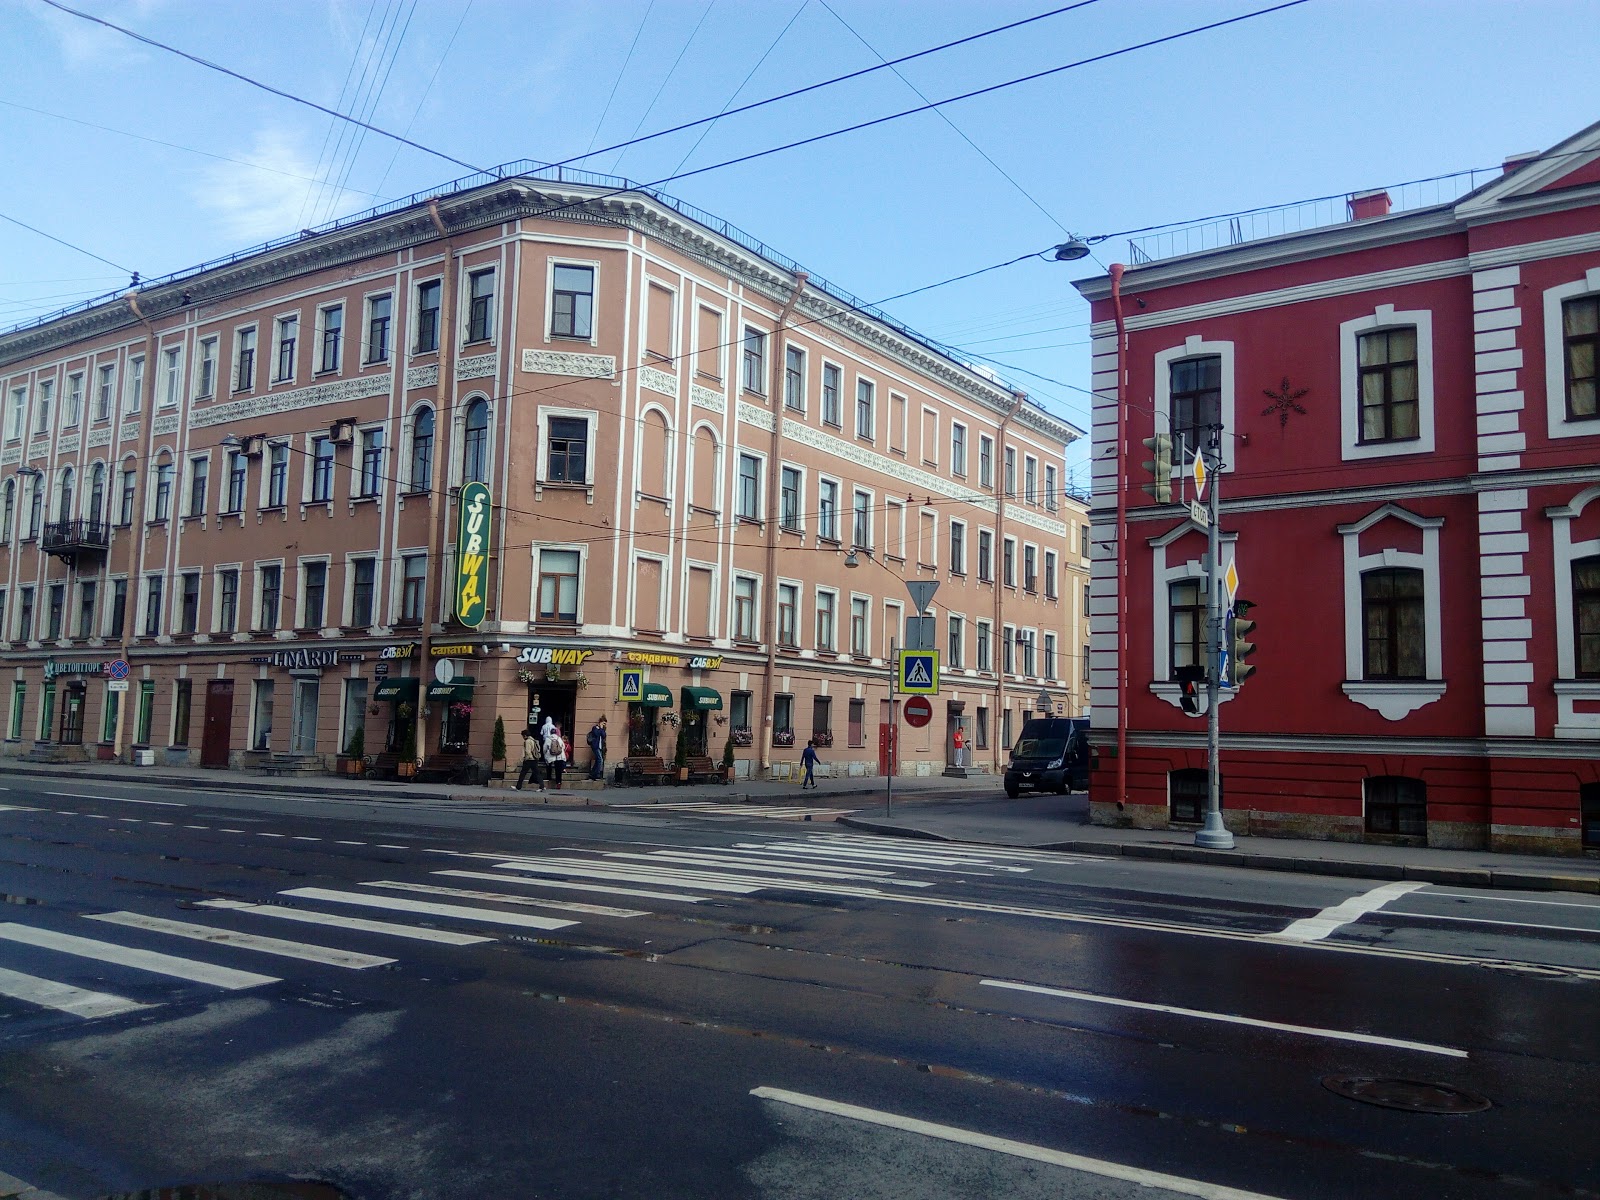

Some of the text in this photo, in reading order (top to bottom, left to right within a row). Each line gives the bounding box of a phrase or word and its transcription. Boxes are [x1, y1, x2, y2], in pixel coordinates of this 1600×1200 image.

[1193, 504, 1207, 524] СТОП
[460, 493, 486, 617] SUBWAY
[380, 644, 414, 659] САБВЭЙ
[516, 647, 594, 665] SUBWAY
[274, 649, 339, 668] LINARDI
[690, 656, 724, 669] САБВЭЙ
[55, 662, 101, 675] ЦВЕТОПТТОРГ
[378, 687, 401, 695] SUBWAY
[430, 687, 455, 695] SUBWAY
[646, 693, 670, 702] SUBWAY
[698, 696, 719, 704] SUBWAY
